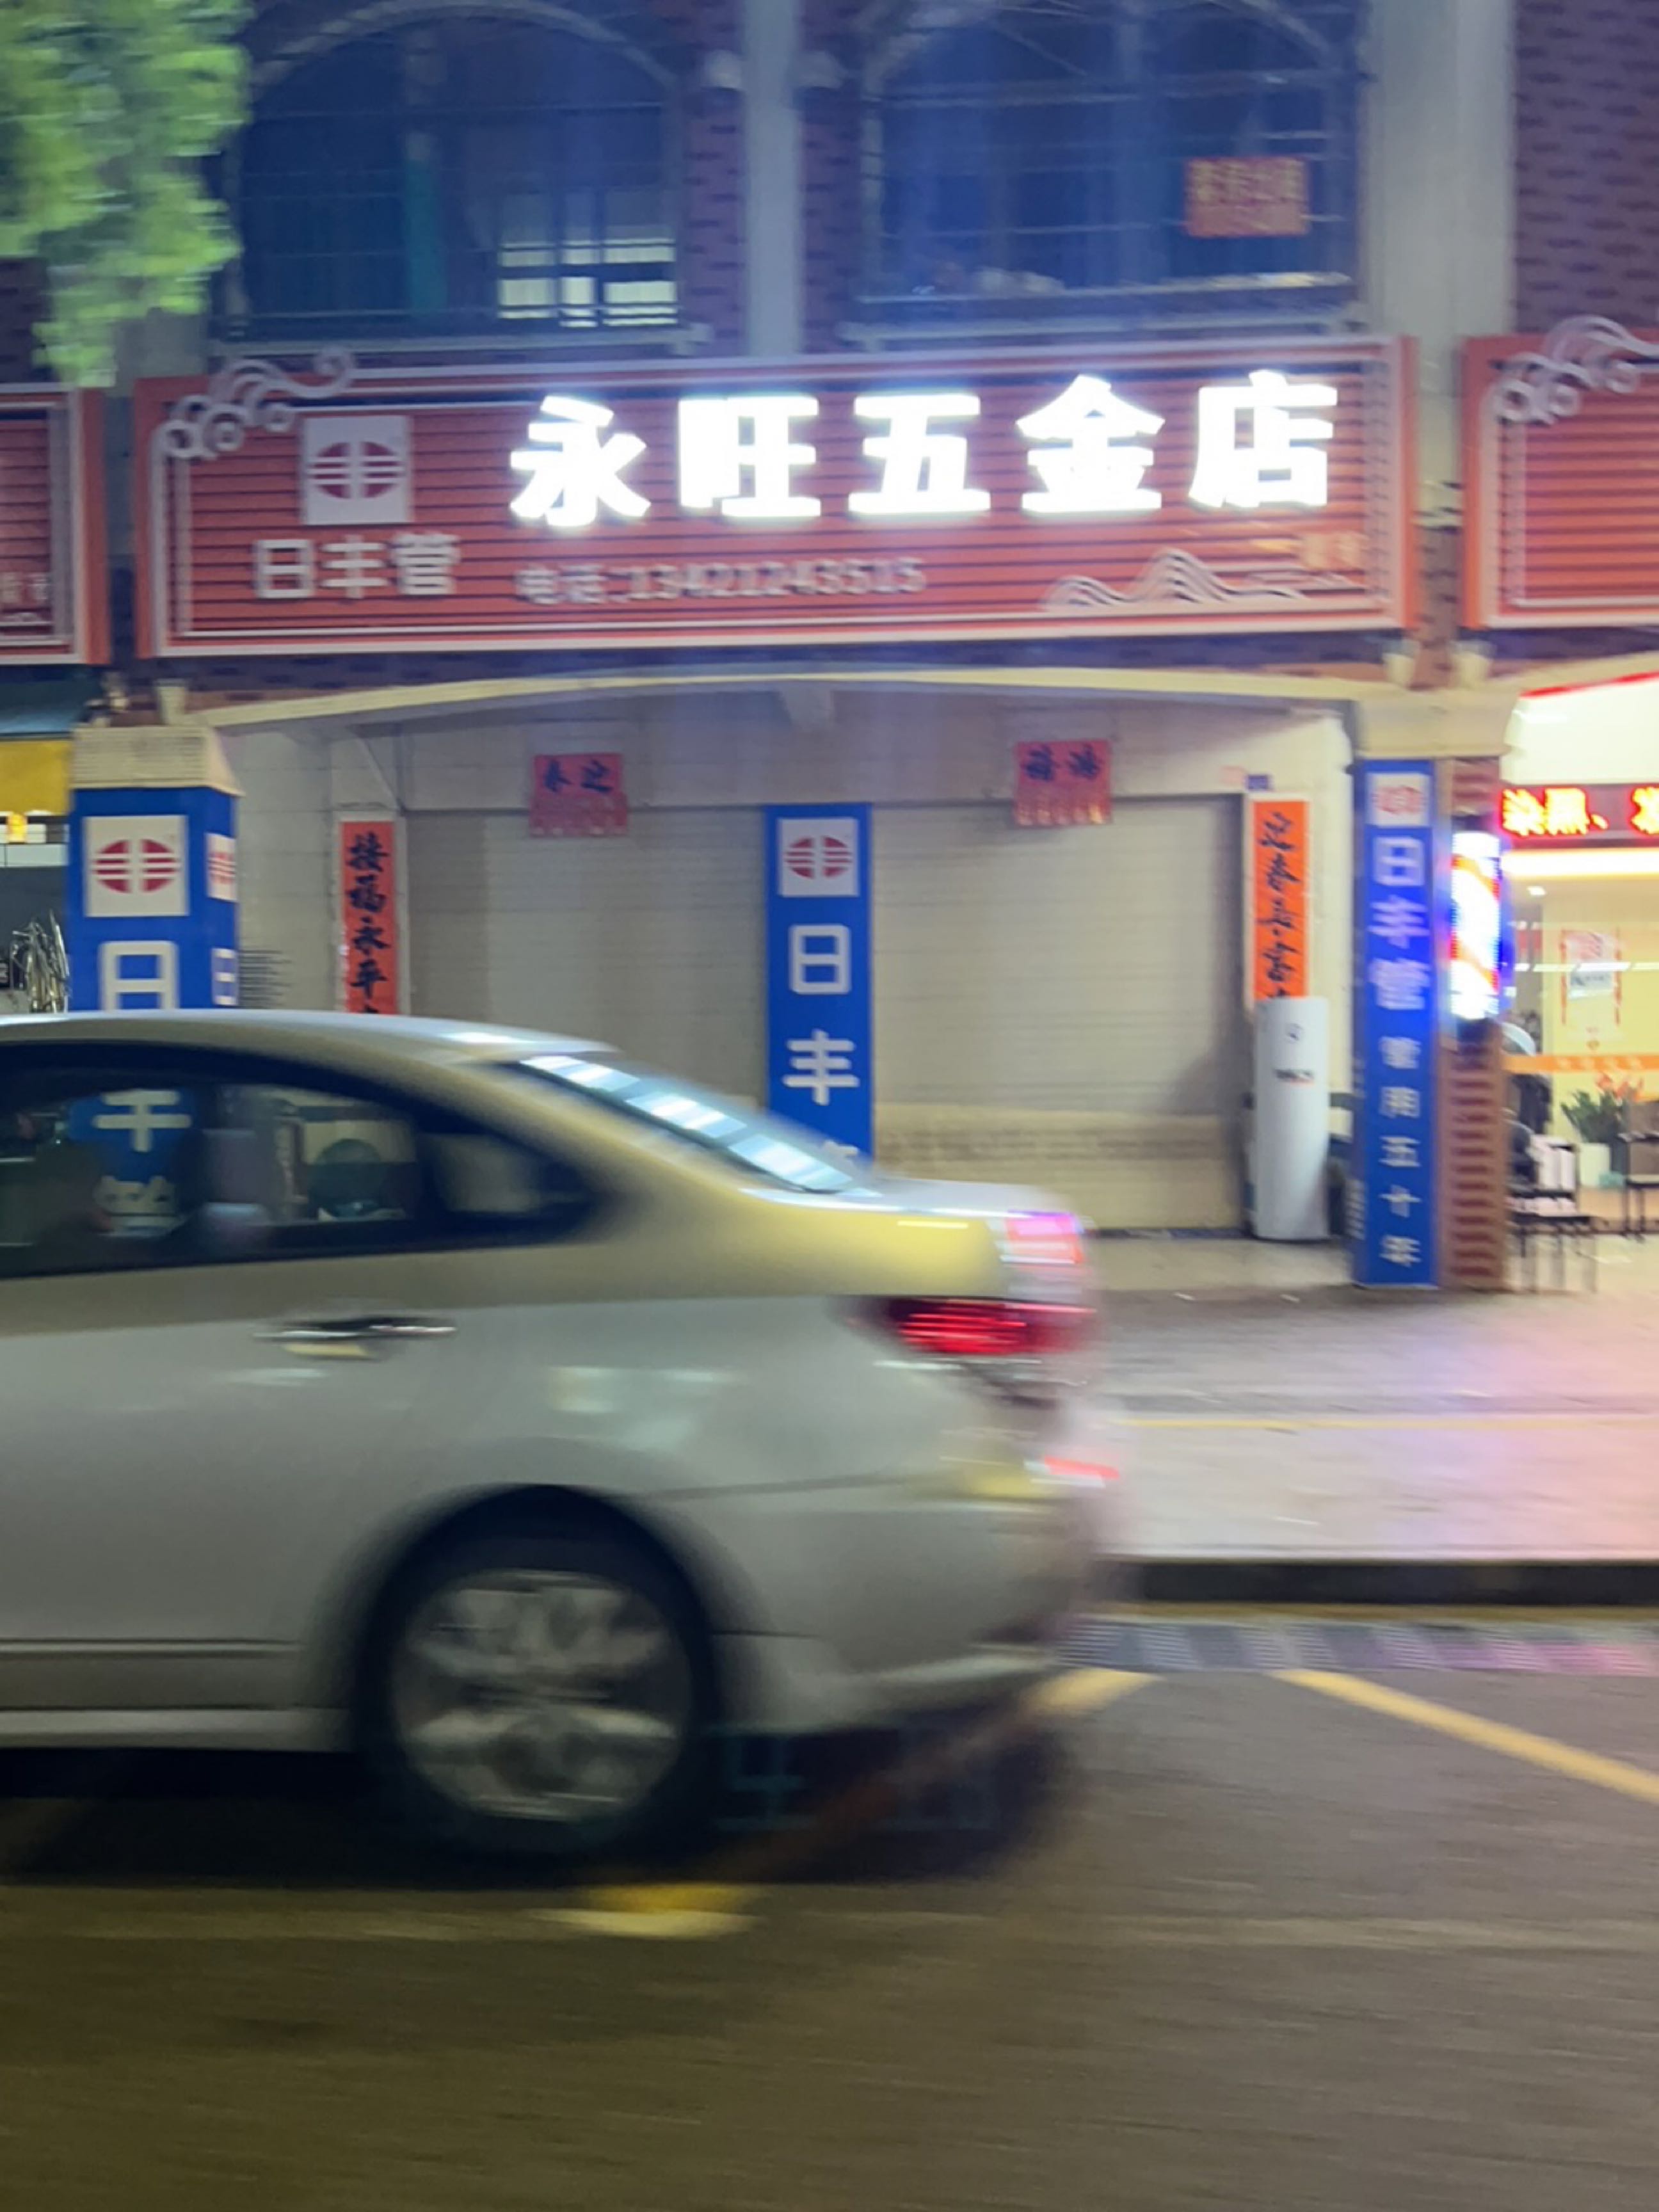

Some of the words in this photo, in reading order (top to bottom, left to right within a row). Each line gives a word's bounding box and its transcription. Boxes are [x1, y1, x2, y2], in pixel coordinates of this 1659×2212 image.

[510, 369, 1338, 527] 永旺五金店
[254, 533, 460, 600] 日丰管
[1367, 836, 1432, 1011] 日丰管
[781, 925, 862, 1156] 日丰
